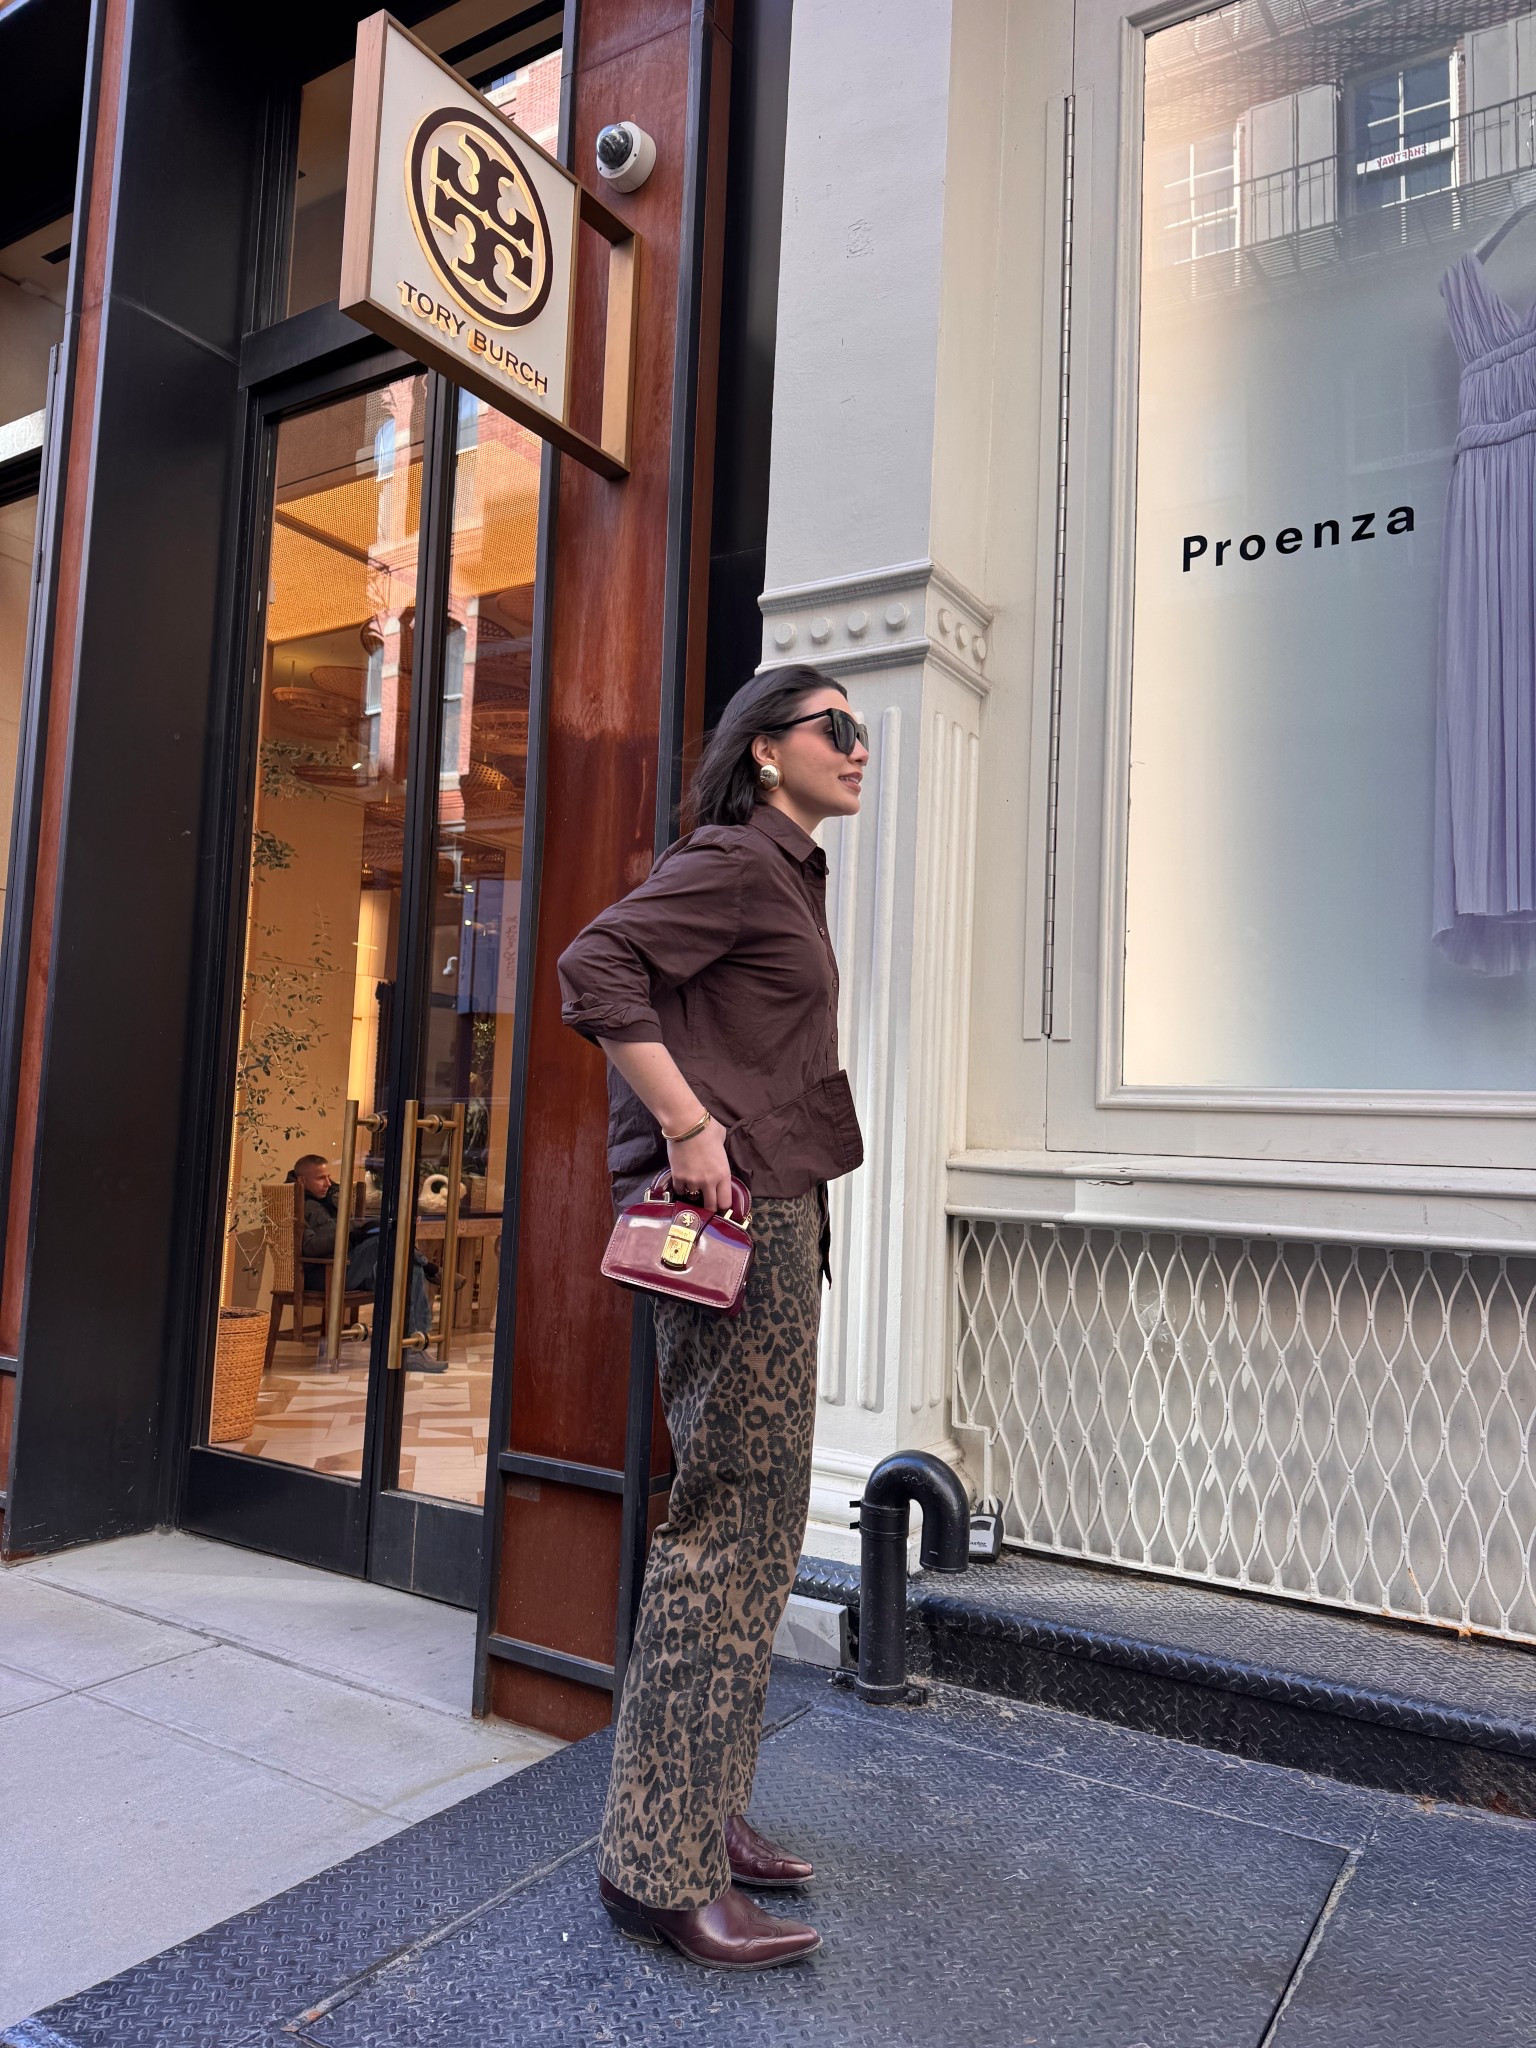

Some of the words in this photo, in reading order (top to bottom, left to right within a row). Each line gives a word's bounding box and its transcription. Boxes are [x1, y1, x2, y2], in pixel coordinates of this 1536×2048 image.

[399, 281, 466, 335] TORY
[471, 329, 548, 394] BURCH
[1182, 505, 1415, 573] Proenza
